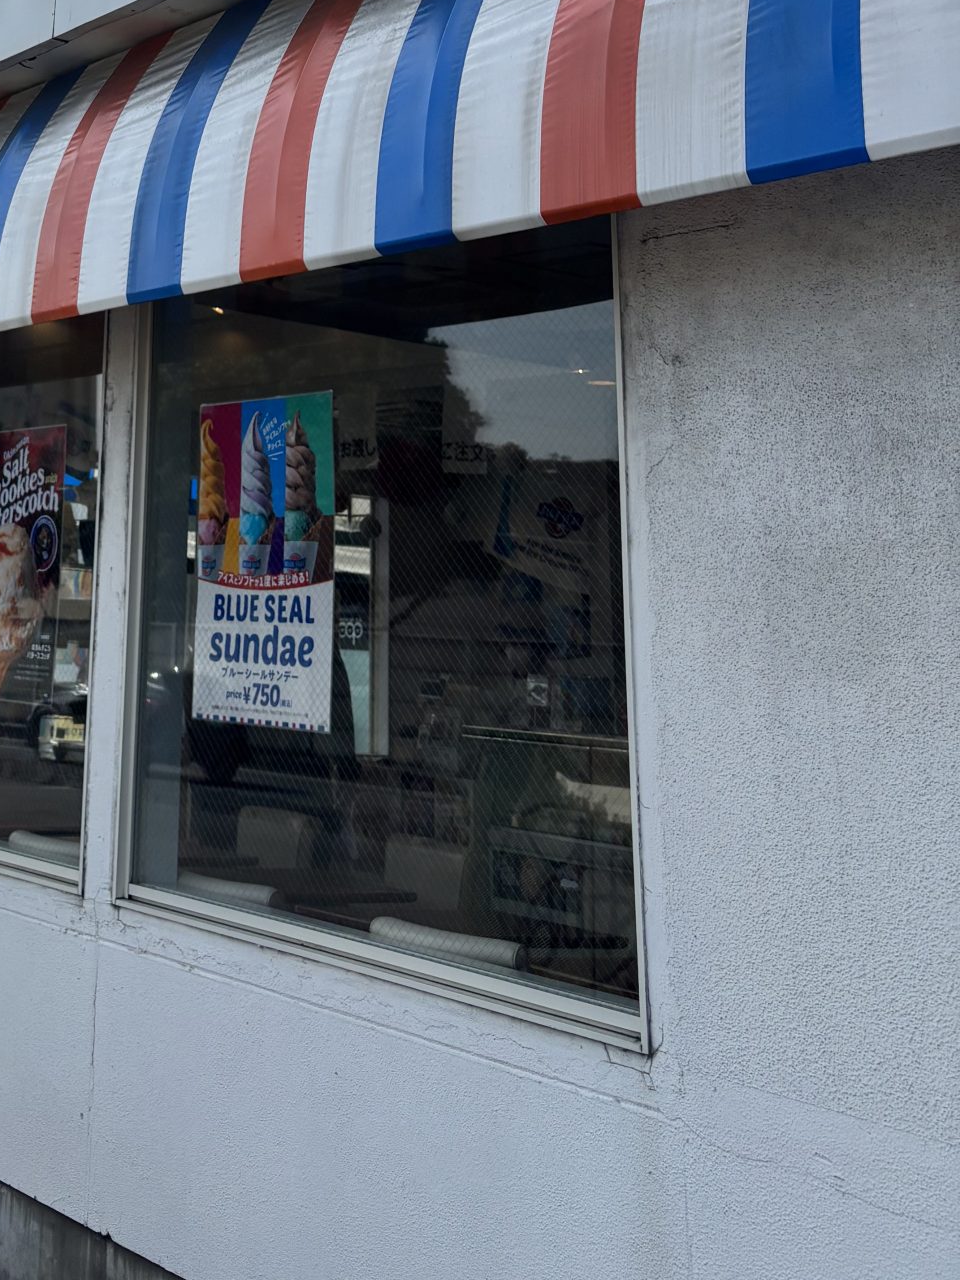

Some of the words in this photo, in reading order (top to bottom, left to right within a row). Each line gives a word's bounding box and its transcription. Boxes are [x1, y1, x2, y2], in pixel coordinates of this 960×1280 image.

[2, 446, 30, 488] Salt
[213, 593, 260, 622] BLUE
[264, 594, 315, 624] SEAL
[209, 625, 315, 667] sundae
[221, 666, 299, 682] ブルーシールサンデー
[243, 683, 281, 707] ¥750
